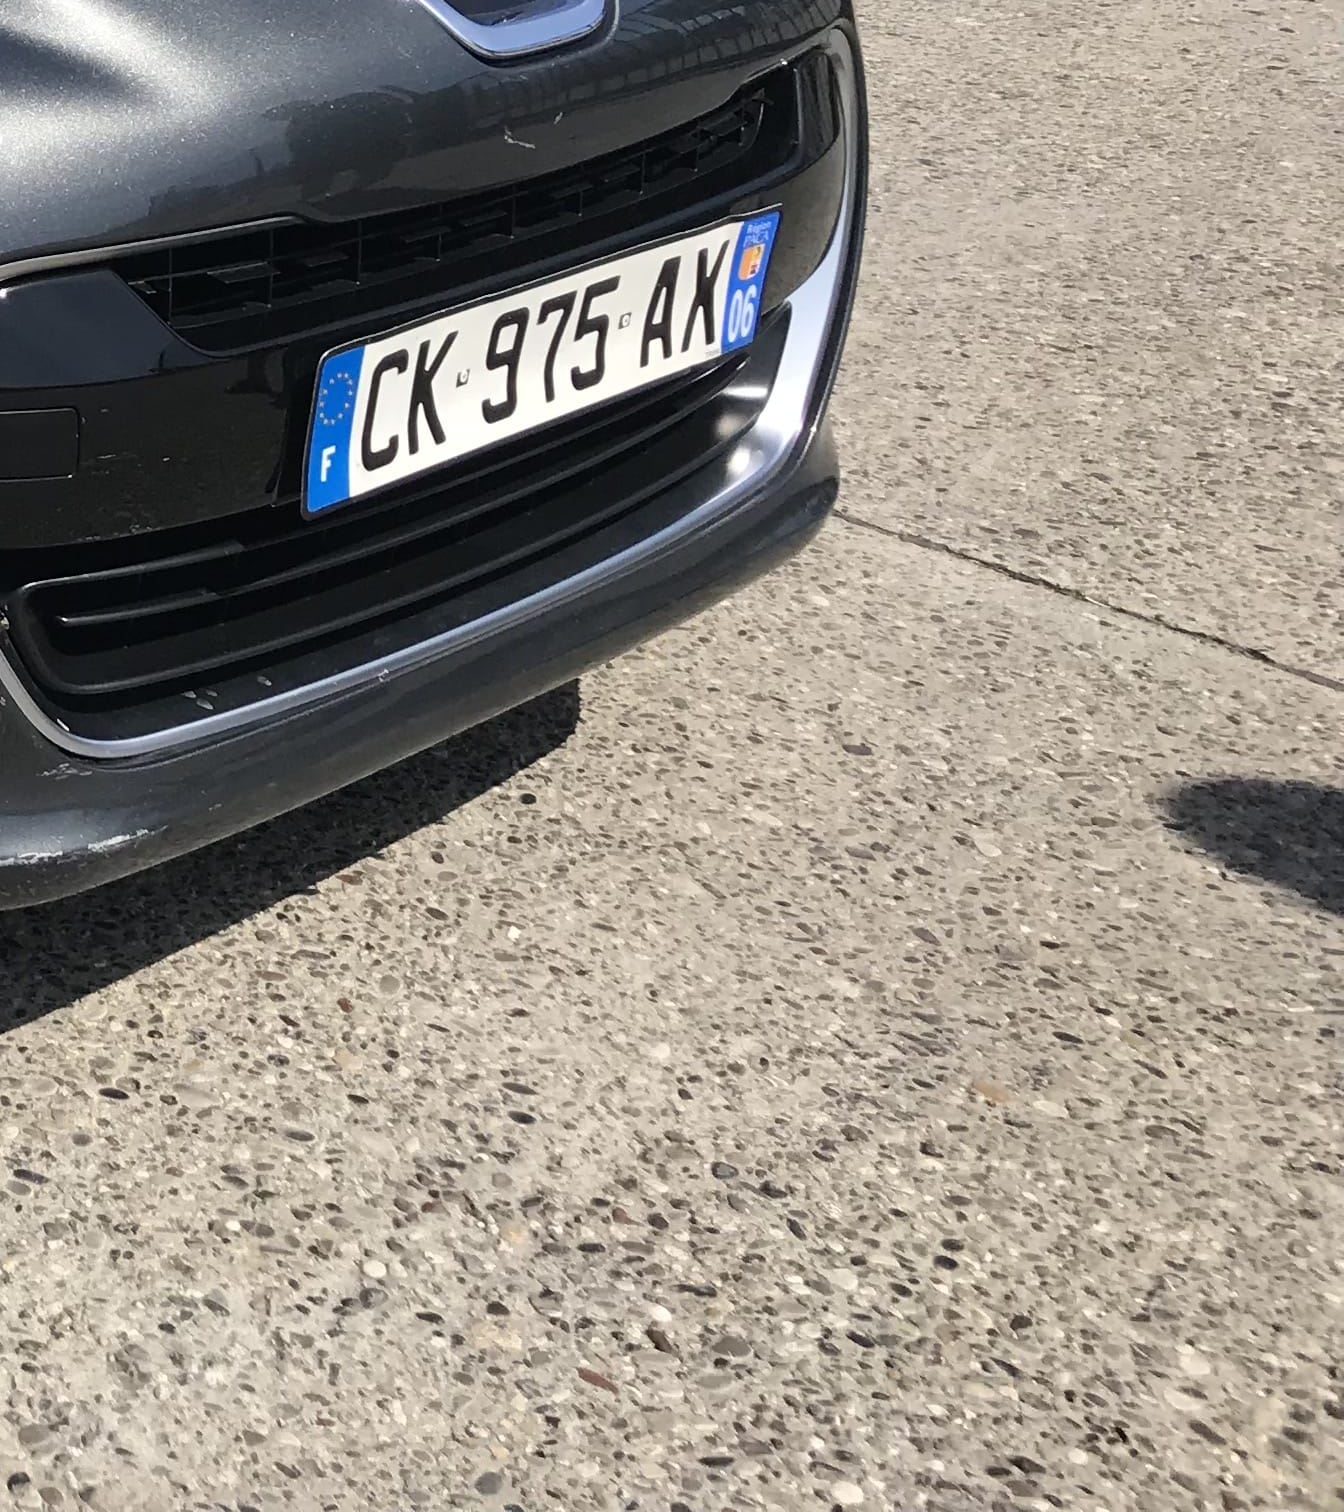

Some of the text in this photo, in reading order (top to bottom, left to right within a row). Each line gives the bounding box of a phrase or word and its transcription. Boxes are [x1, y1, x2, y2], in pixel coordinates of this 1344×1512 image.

[727, 284, 757, 343] 06
[361, 240, 730, 471] CK 975 AX
[321, 445, 336, 482] F
